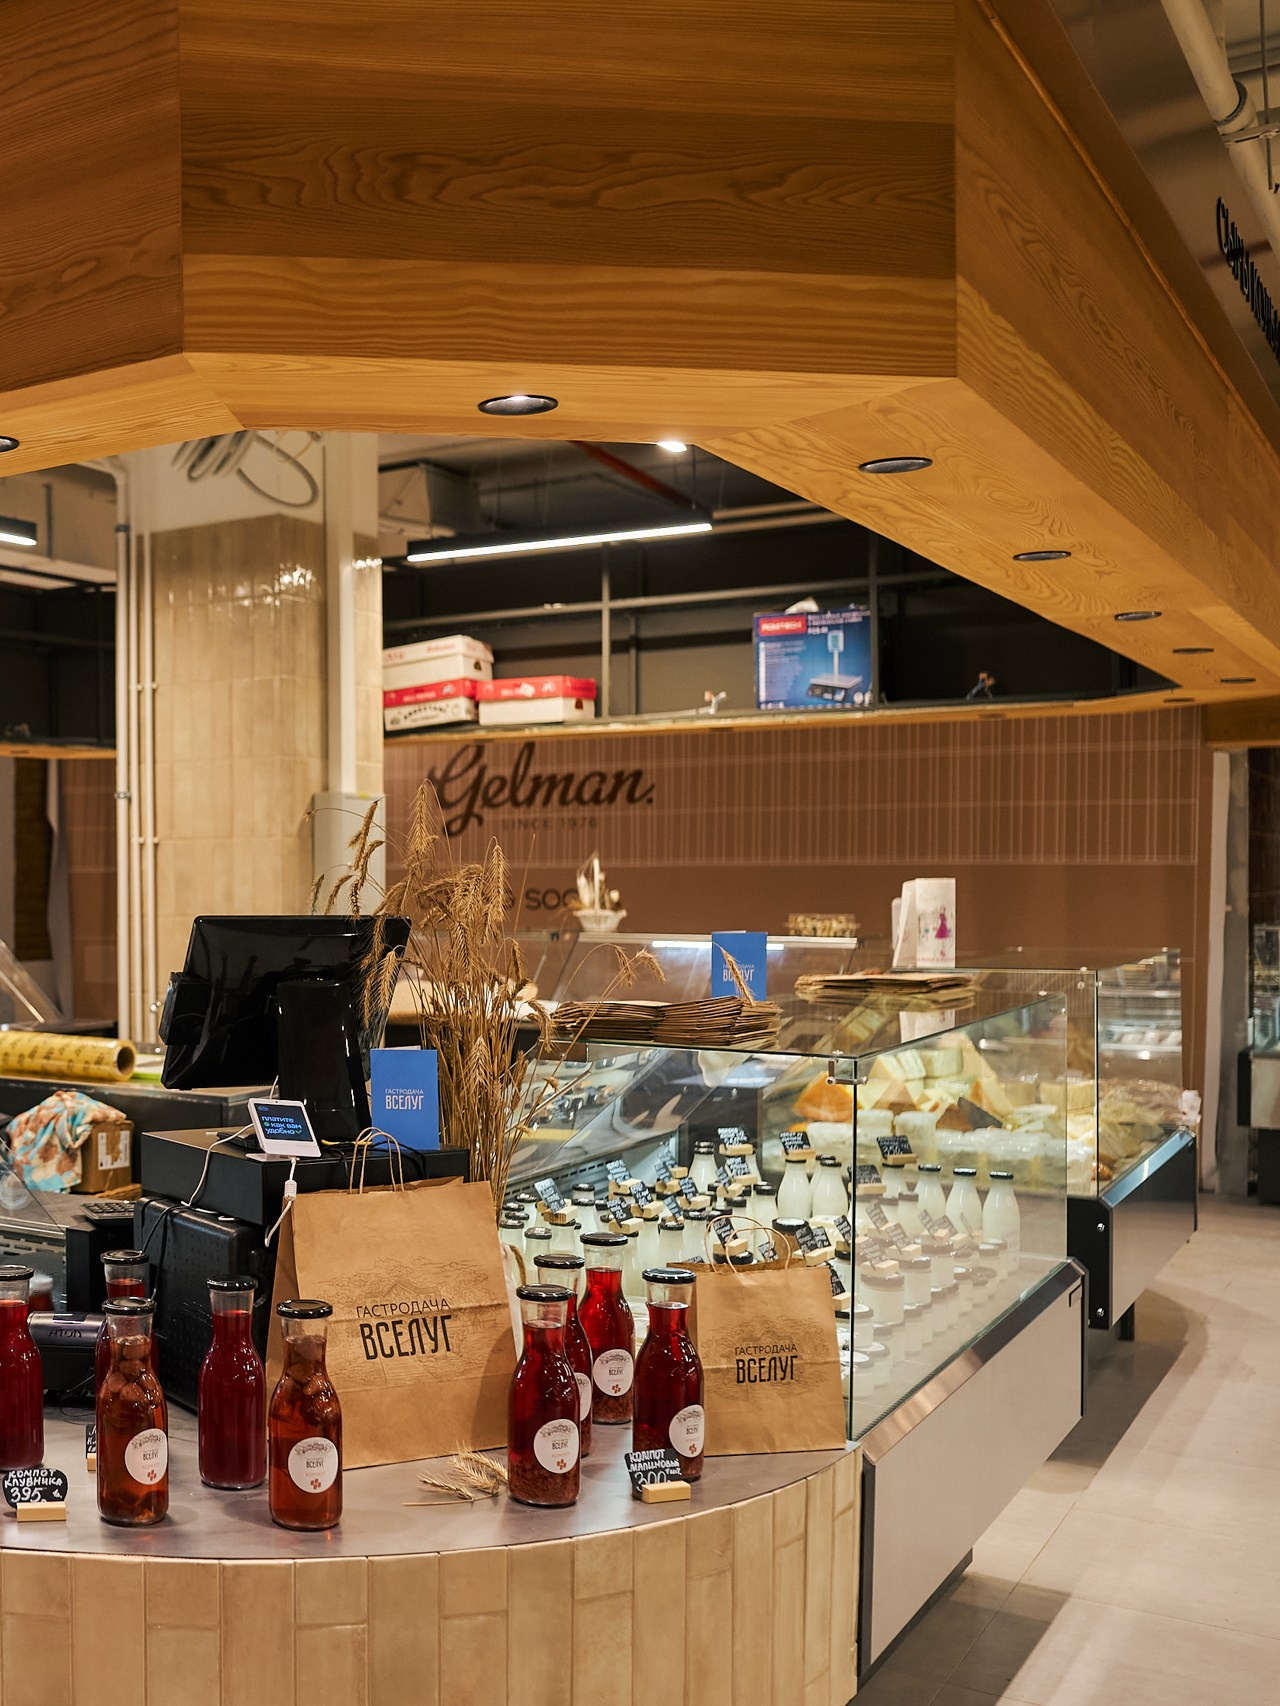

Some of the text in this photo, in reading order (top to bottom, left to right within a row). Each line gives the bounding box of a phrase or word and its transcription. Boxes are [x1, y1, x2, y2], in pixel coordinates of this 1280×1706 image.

[385, 1095, 424, 1110] ВСЕЛУГ
[356, 1297, 451, 1319] ГАСТРОДАЧА
[359, 1315, 453, 1360] ВСЕЛУГ
[734, 1343, 798, 1356] ГАСТРОДАЧА
[736, 1355, 799, 1383] ВСЕЛУГ
[8, 1469, 56, 1482] КОМПОТ
